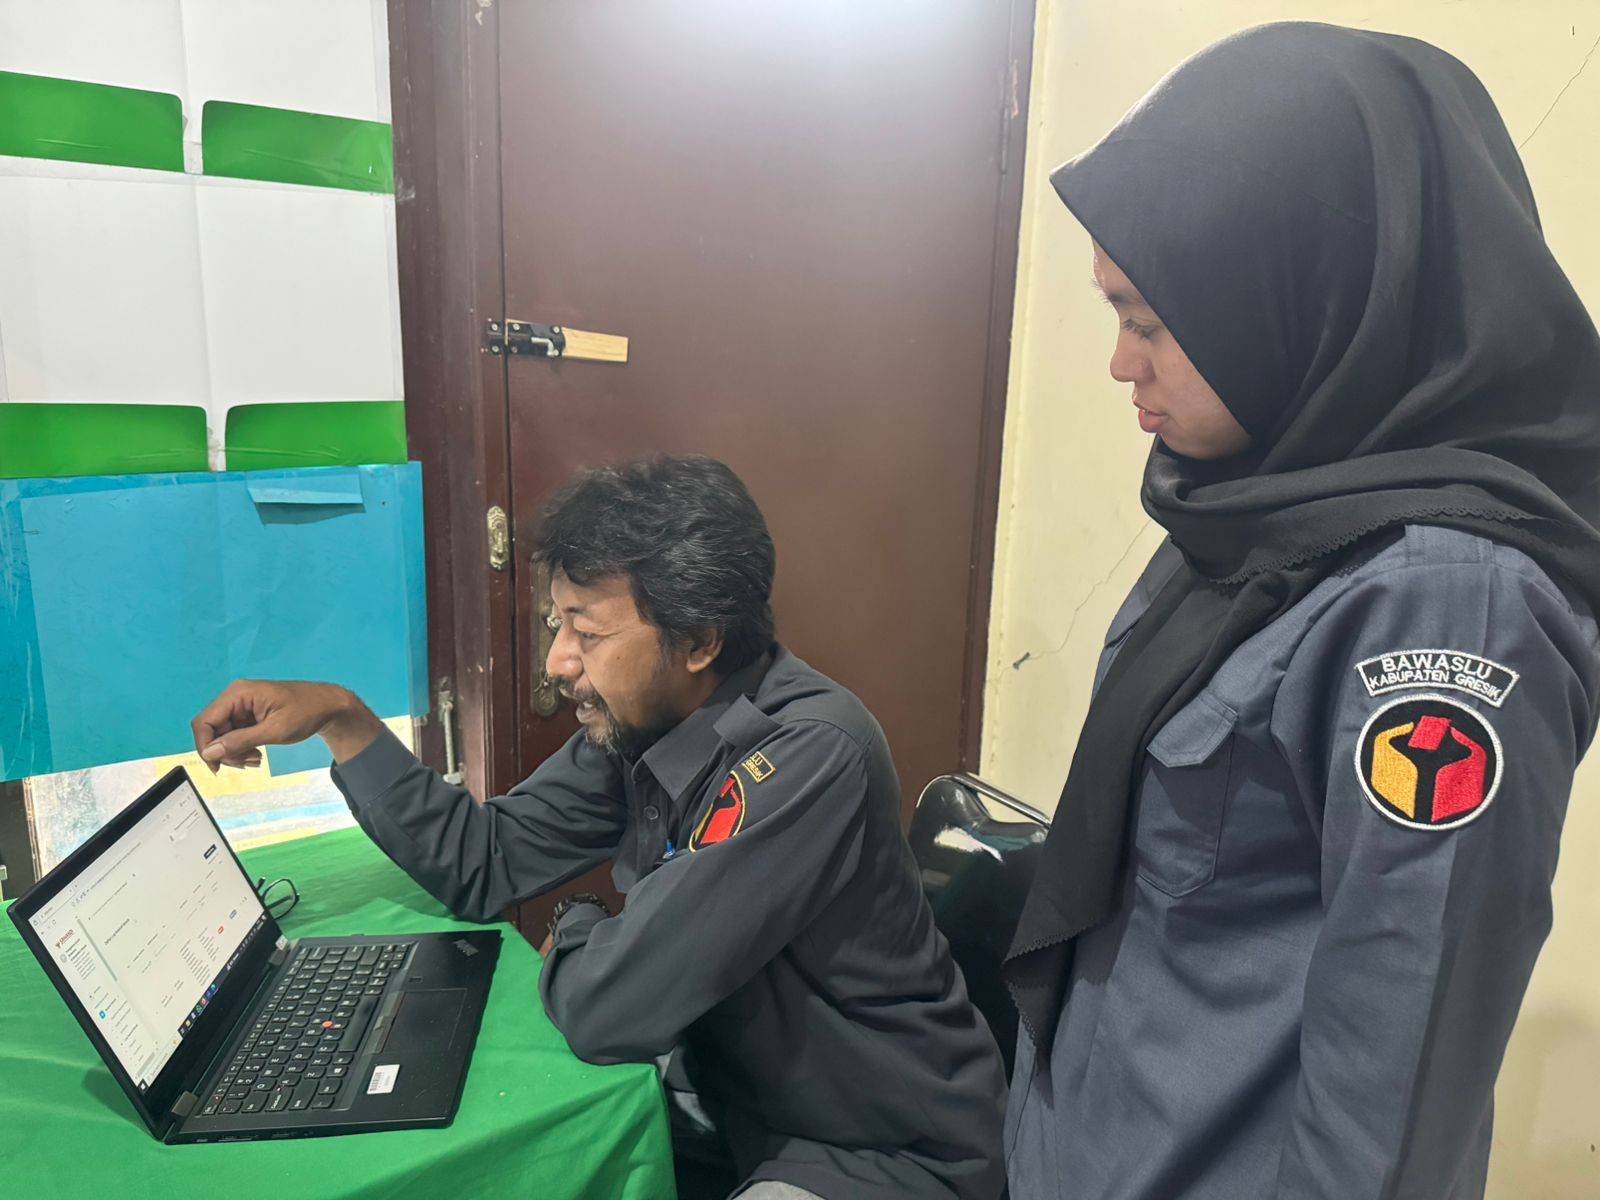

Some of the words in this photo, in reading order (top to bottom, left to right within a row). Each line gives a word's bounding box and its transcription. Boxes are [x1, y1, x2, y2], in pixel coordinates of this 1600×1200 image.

[1382, 654, 1492, 679] BAWASLU
[1369, 670, 1450, 689] KABUPATEN
[1454, 673, 1503, 701] GRESIK
